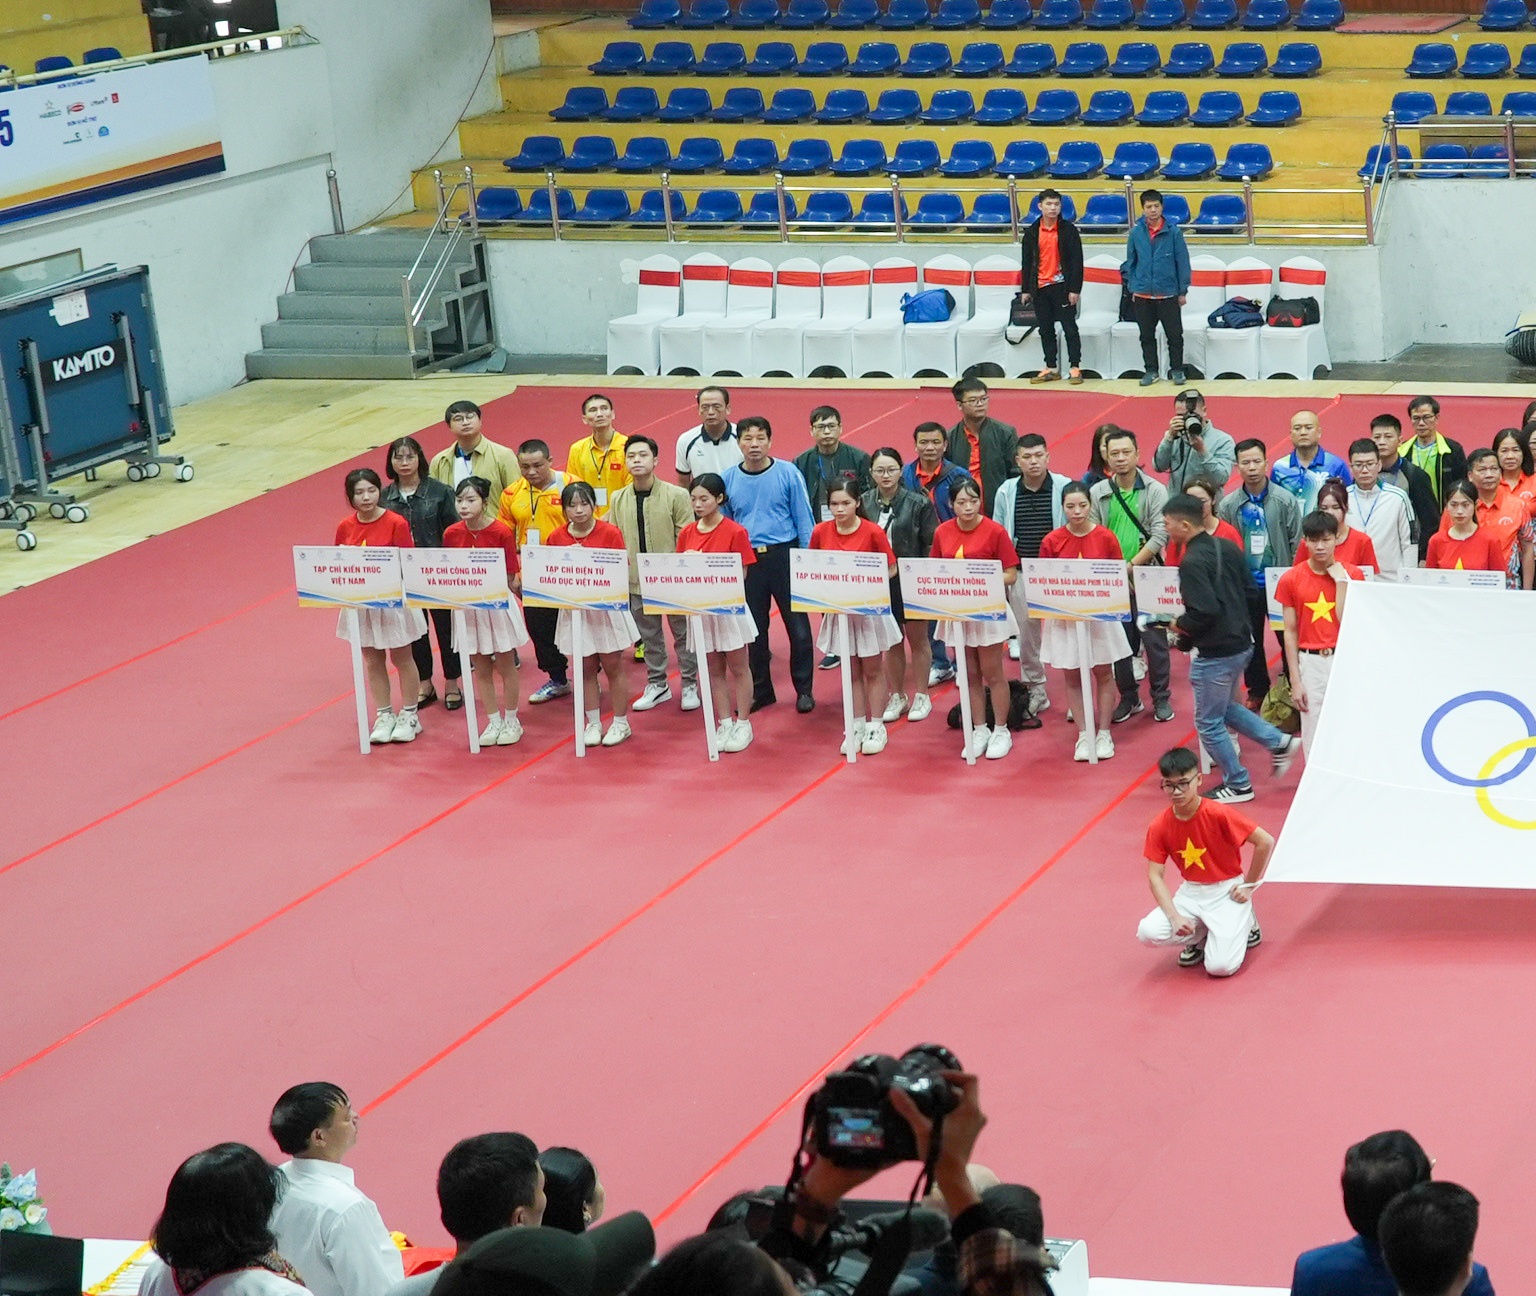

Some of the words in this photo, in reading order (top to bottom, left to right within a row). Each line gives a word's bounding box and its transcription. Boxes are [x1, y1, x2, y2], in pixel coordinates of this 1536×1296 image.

[52, 345, 115, 381] KAMITO
[314, 565, 327, 575] TẠP
[329, 565, 341, 573] CHÍ
[343, 565, 361, 574] KIẾN
[363, 565, 381, 574] TRÚC
[545, 565, 560, 575] TẠP
[561, 565, 574, 574] CHÍ
[575, 565, 592, 576] ĐIỆN
[331, 576, 346, 586] VIỆT
[540, 576, 557, 585] GIÁO
[559, 577, 573, 587] DỤC
[576, 577, 591, 587] VIỆT
[593, 579, 610, 587] NAM
[917, 577, 932, 586] CỤC
[934, 575, 960, 585] TRUYỀN
[962, 577, 986, 585] THÔNG
[918, 586, 937, 596] CÔNG
[939, 588, 949, 596] AN
[951, 588, 971, 596] NHÂN
[973, 588, 989, 597] DÂN
